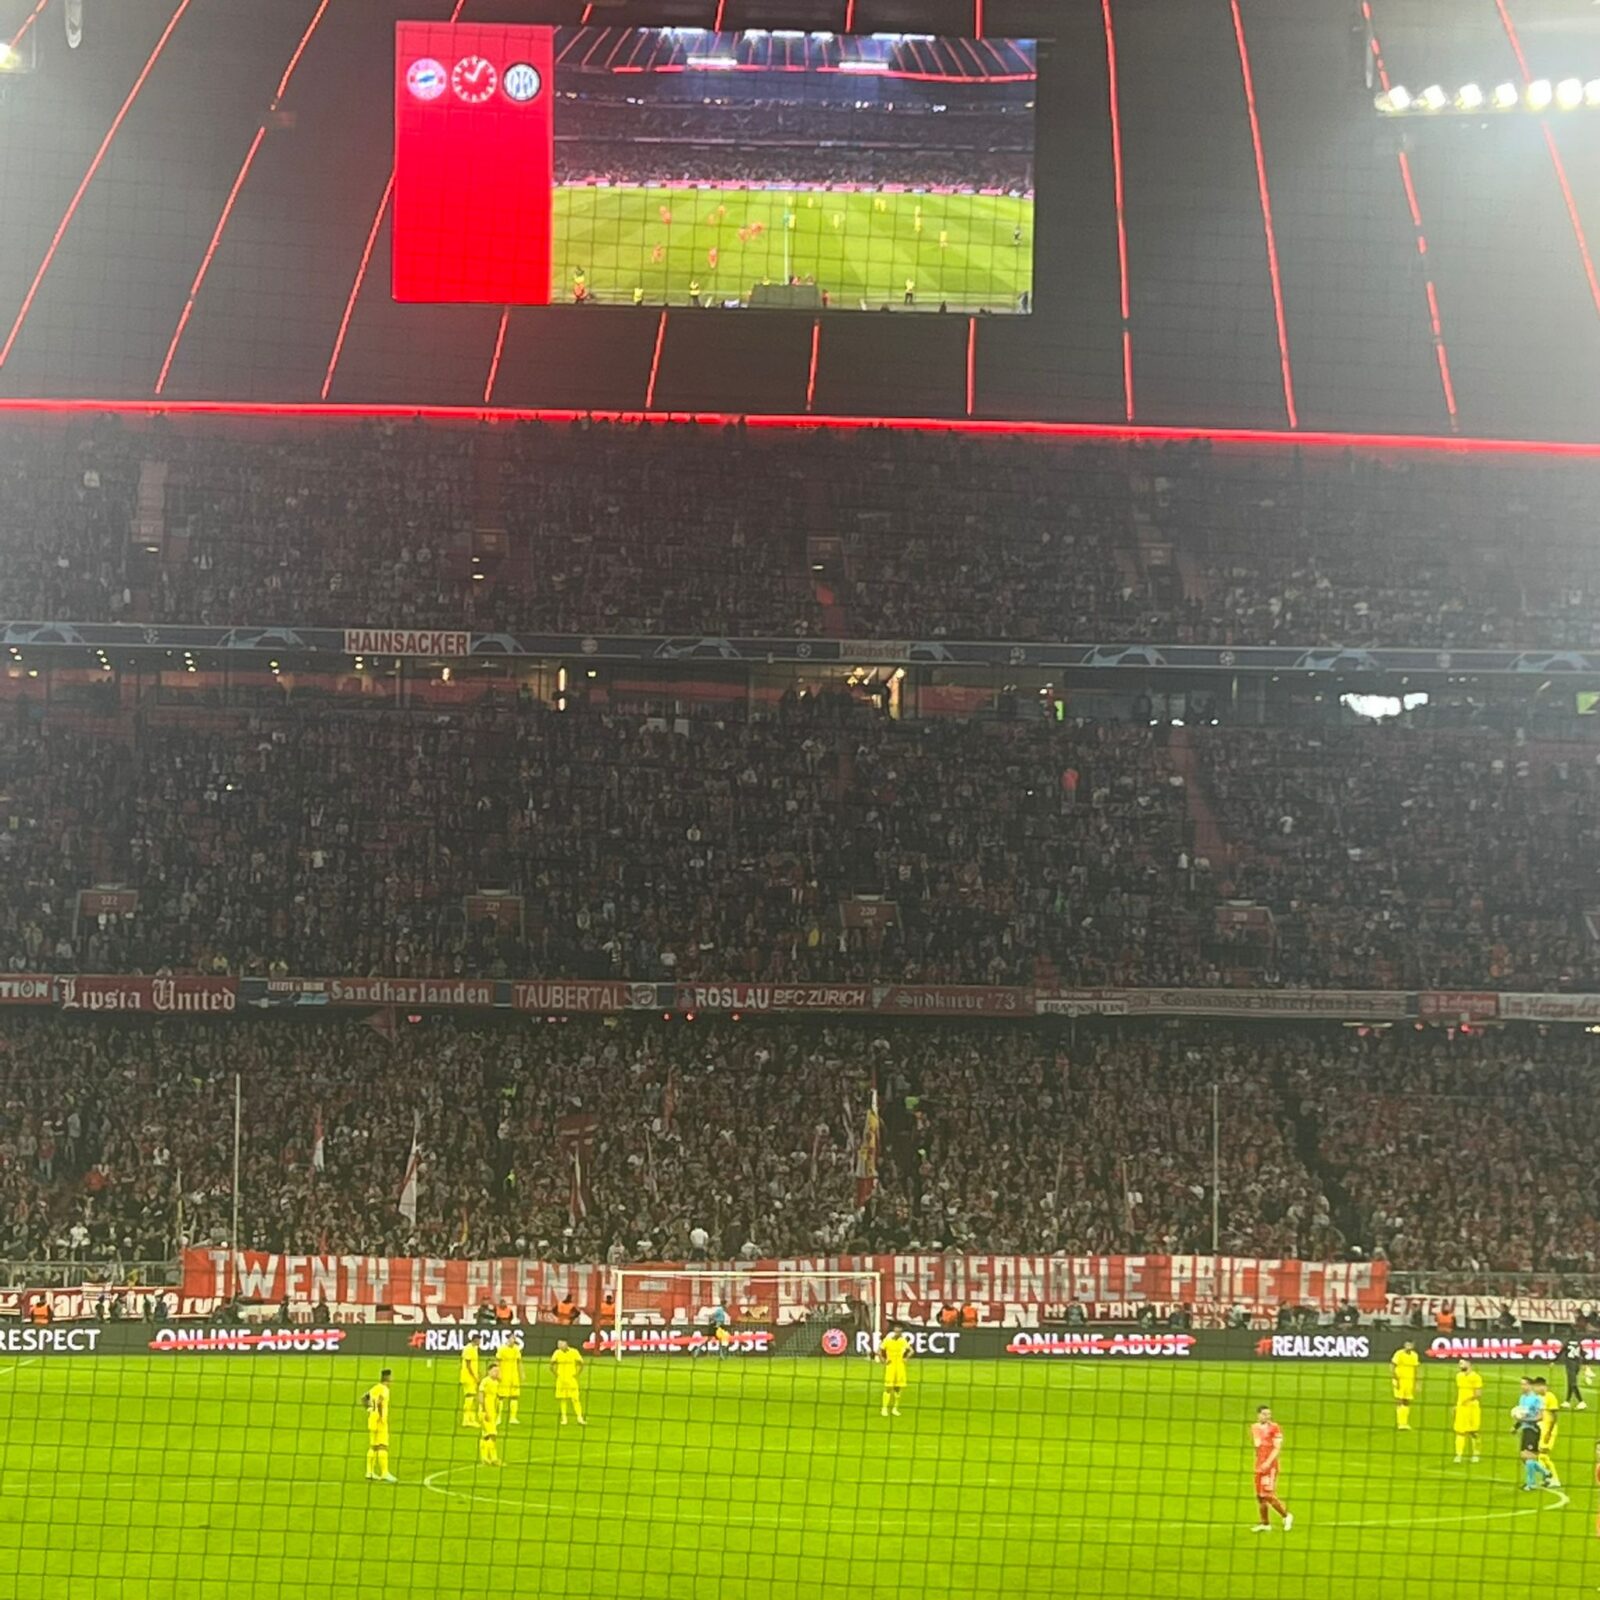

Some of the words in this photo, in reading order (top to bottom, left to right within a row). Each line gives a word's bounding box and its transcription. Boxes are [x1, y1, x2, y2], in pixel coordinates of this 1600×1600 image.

[347, 632, 468, 654] HAINSACKER
[152, 977, 236, 1011] United
[331, 980, 490, 1004] Sandharlanden
[514, 984, 624, 1010] TAUBERTAL
[208, 1250, 390, 1304] TWENTY
[410, 1257, 446, 1305] IS
[894, 1255, 1147, 1303] REASONABLE
[1171, 1255, 1281, 1305] PRICE
[1301, 1261, 1373, 1306] CAP
[155, 1328, 251, 1351] ONLINE
[257, 1328, 340, 1351] ABUSE
[856, 1331, 960, 1354] RPECT
[1012, 1332, 1105, 1355] ONLINE
[1109, 1333, 1191, 1356] ABUSE
[1430, 1337, 1523, 1359] ONLINE
